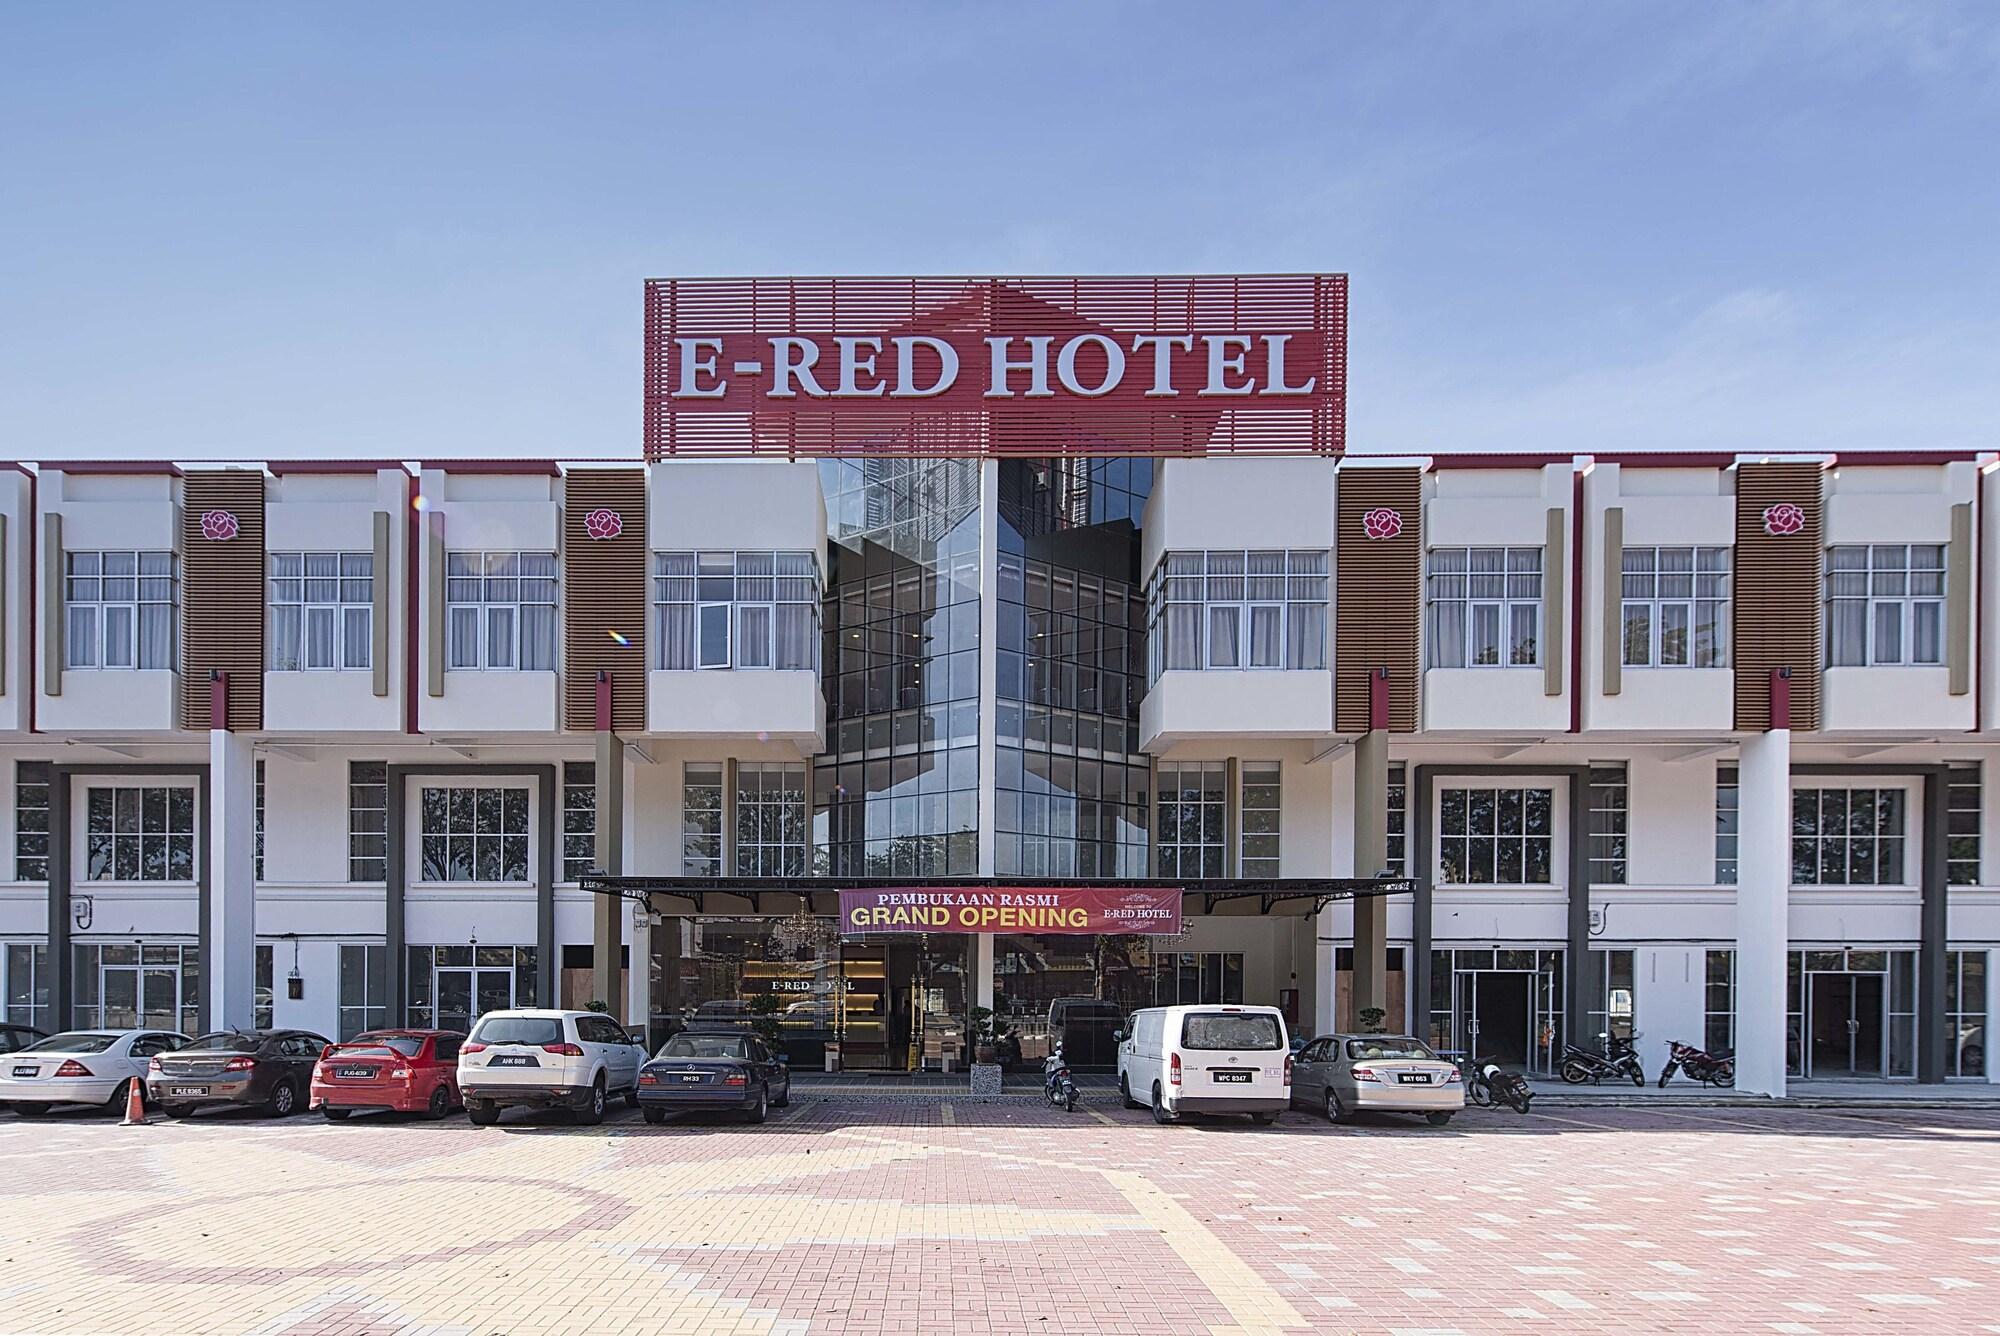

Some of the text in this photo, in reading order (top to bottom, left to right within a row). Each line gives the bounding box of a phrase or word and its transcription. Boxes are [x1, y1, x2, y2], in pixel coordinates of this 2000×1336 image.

[671, 333, 1316, 399] E-RED HOTEL
[877, 893, 1060, 907] PEMBUKAAN RASMI
[850, 906, 1088, 927] GRAND OPENING
[1137, 909, 1173, 919] HOTEL
[772, 981, 810, 991] E-RED
